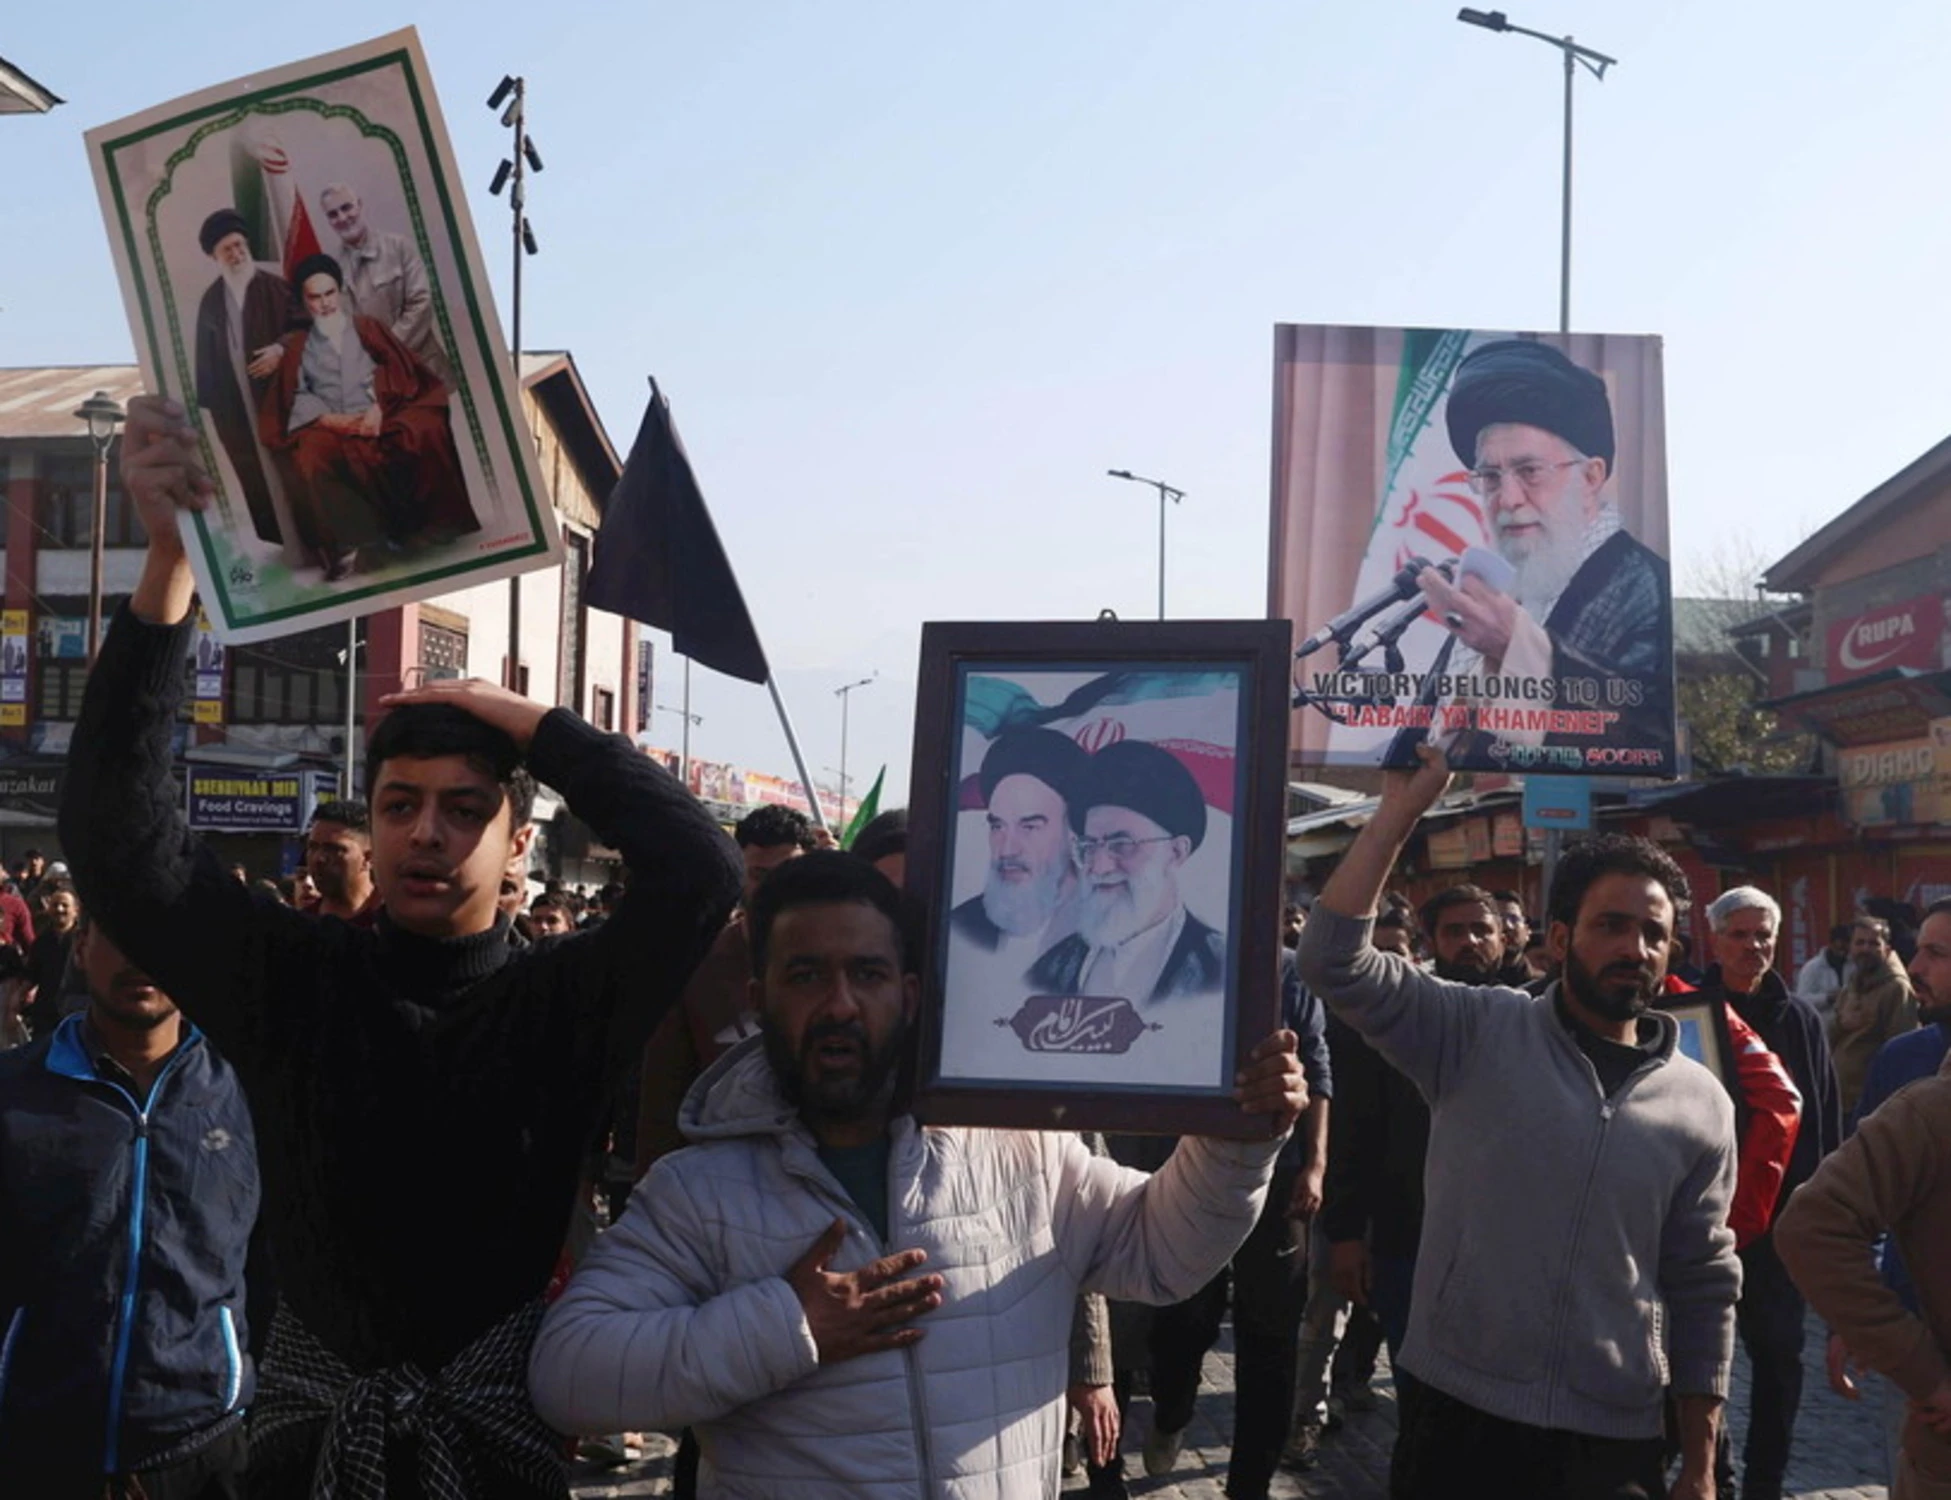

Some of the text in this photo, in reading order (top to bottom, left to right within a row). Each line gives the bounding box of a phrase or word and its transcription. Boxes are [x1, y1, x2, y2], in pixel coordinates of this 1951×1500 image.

[1858, 613, 1915, 646] RUPA
[1313, 673, 1644, 706] VICTORY BELONGS TO US
[1441, 705, 1468, 729] YA
[199, 799, 292, 817] Food Cravings
